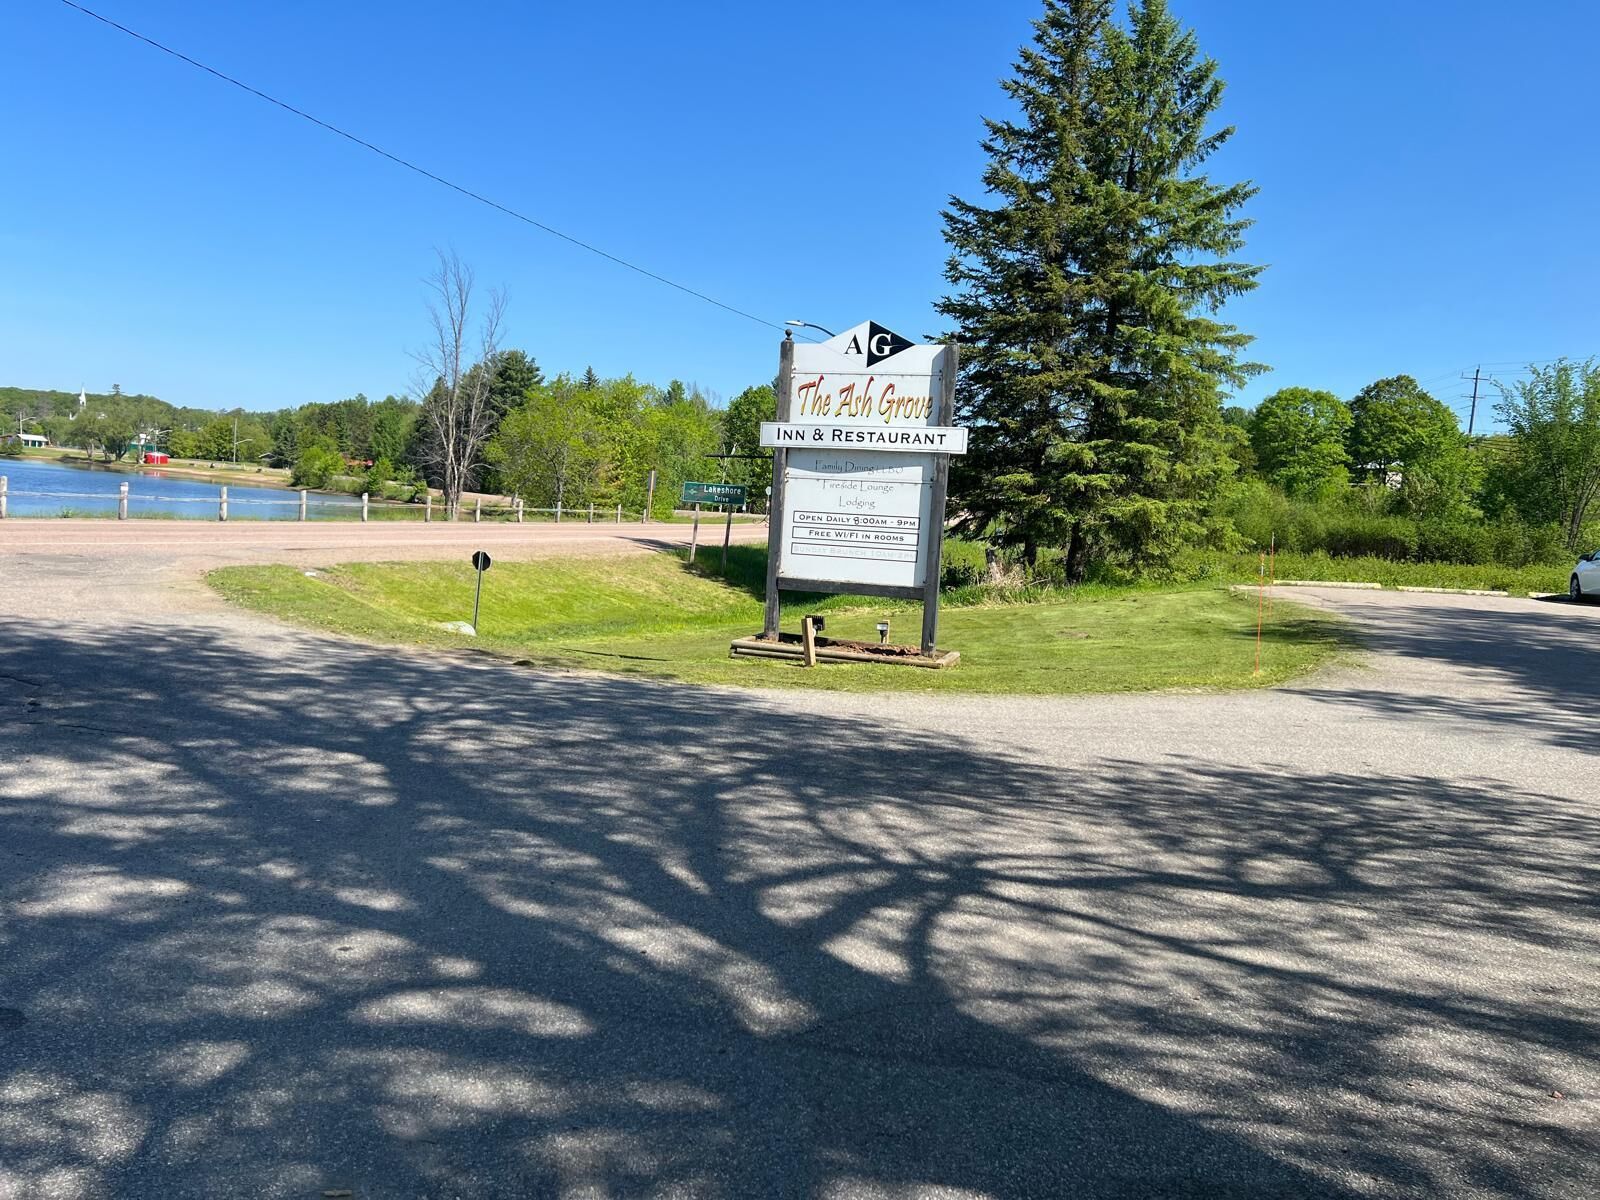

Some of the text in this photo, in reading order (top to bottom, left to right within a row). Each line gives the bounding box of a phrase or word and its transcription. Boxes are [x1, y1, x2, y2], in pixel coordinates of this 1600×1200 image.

[798, 374, 934, 424] The Ash Grove
[812, 428, 825, 442] &
[814, 459, 843, 473] Family
[845, 461, 874, 476] Dining
[703, 485, 742, 495] Lakeshore
[859, 480, 894, 495] Lounge
[714, 495, 730, 503] Drive
[838, 496, 876, 510] Lodging
